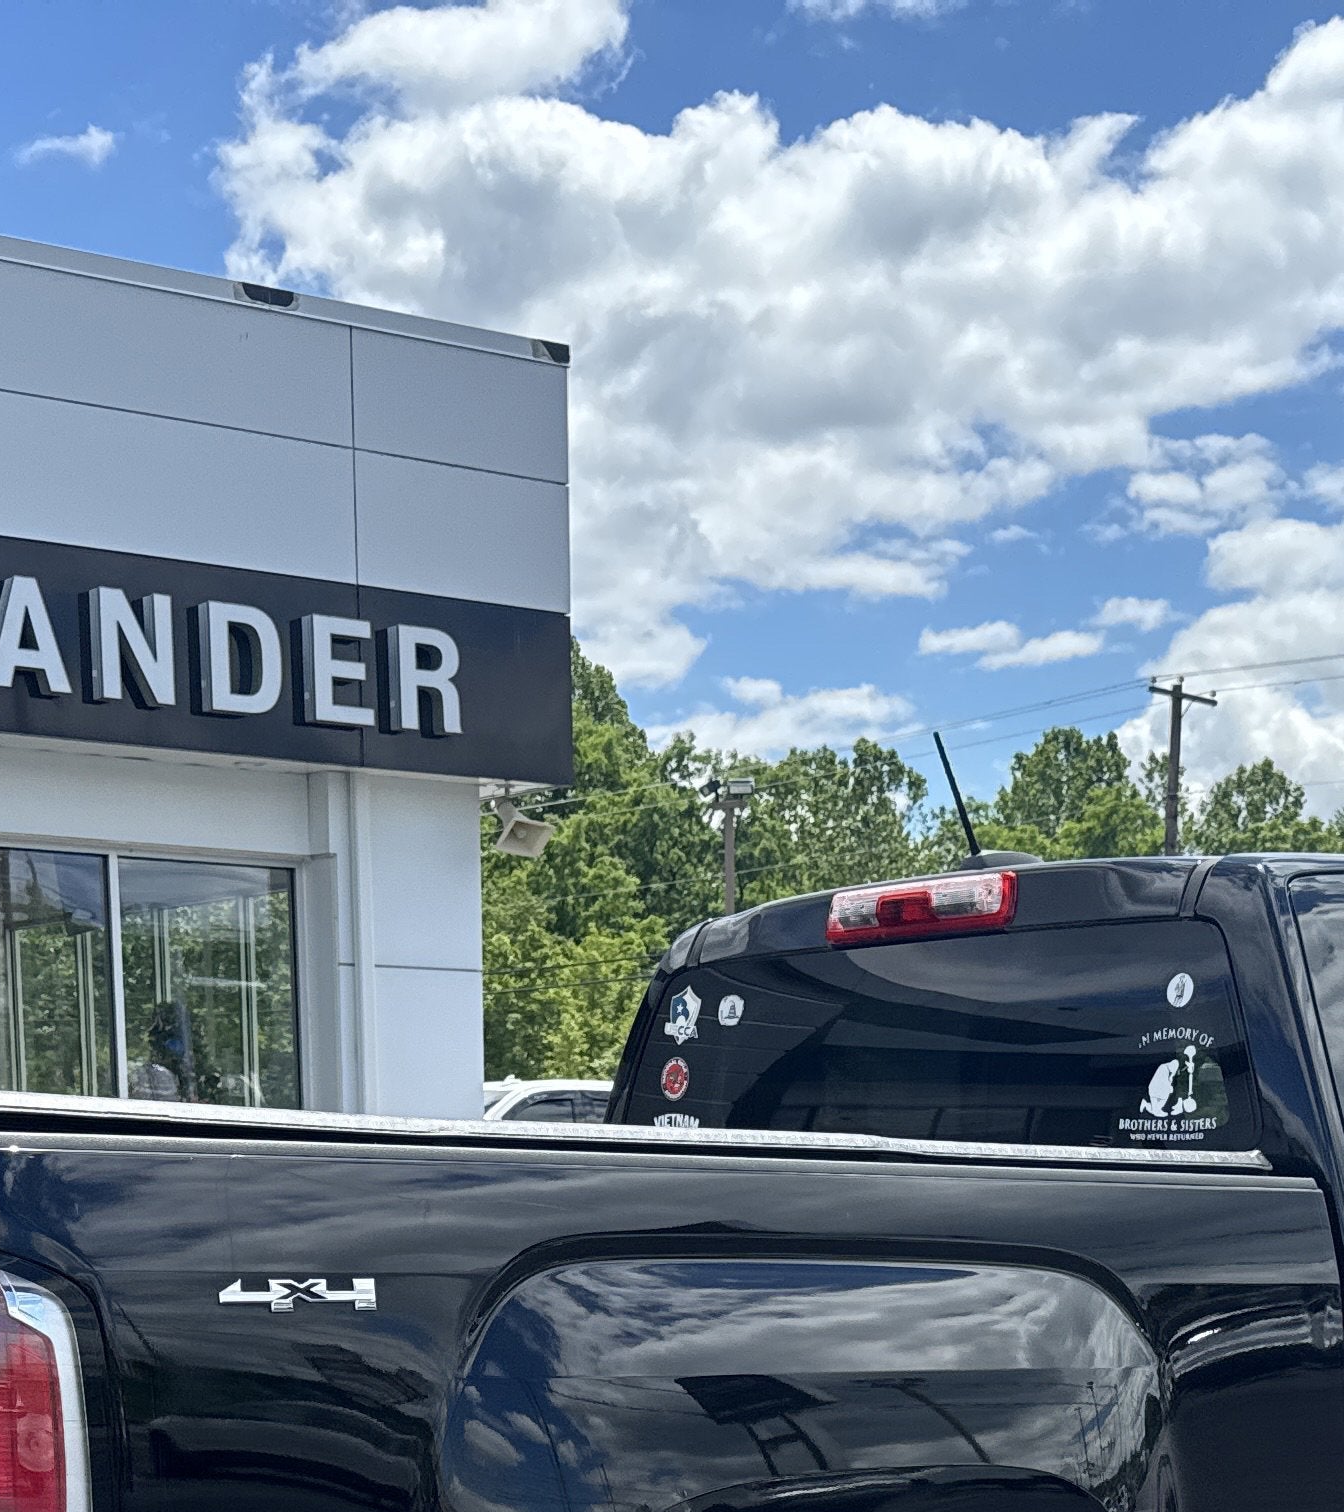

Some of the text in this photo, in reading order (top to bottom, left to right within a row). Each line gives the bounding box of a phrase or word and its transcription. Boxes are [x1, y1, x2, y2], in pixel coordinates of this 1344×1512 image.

[1153, 1026, 1200, 1042] MEMORY
[1198, 1033, 1215, 1048] OF
[653, 1113, 700, 1128] VIETNAM
[1118, 1117, 1217, 1132] BROTHERS & SISTERS
